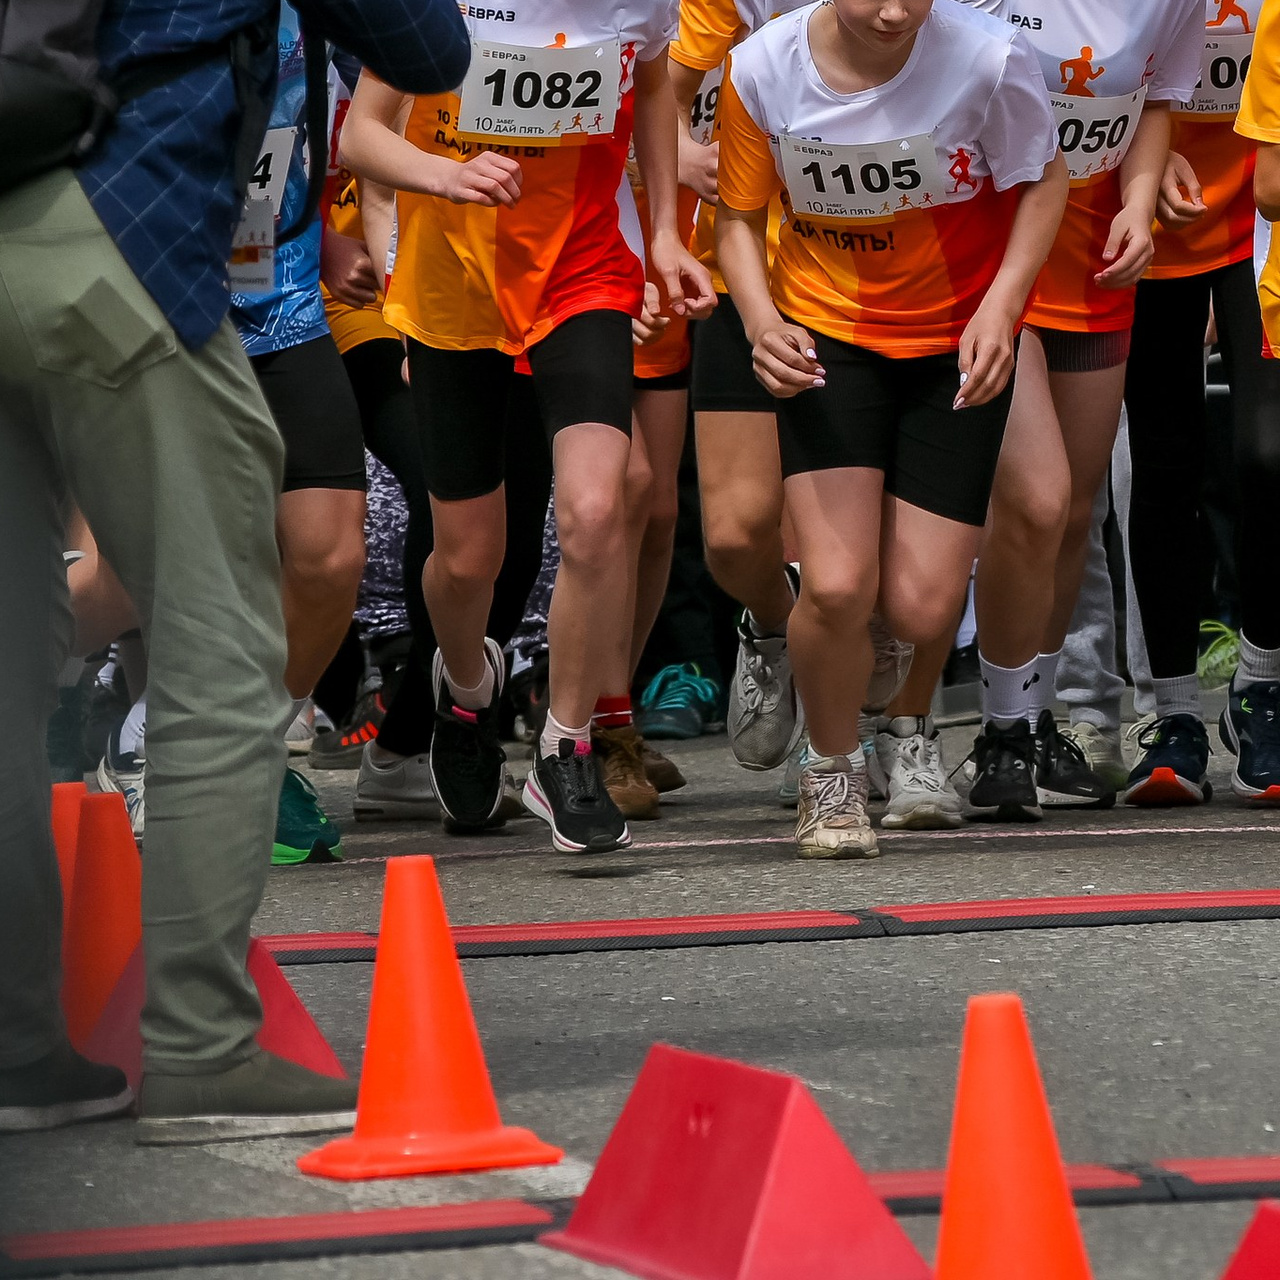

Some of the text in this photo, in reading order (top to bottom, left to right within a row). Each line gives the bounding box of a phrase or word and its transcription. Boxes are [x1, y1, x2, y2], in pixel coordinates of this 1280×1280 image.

[468, 6, 516, 22] ЕВРАЗ
[1011, 14, 1043, 30] РАЗ
[491, 50, 527, 62] ЕВРАЗ
[484, 68, 602, 110] 1082
[1197, 102, 1239, 112] ДАЙ ПЯТ
[474, 117, 493, 131] 10
[494, 124, 545, 134] ДАЙ ПЯТЬ
[1058, 114, 1130, 153] 050
[801, 146, 834, 157] ЕВРАЗ
[802, 158, 922, 195] 1105
[806, 200, 824, 214] 10
[826, 206, 876, 216] ДАЙ ПЯТЬ
[792, 219, 895, 252] АЙ ПЯТЬ!
